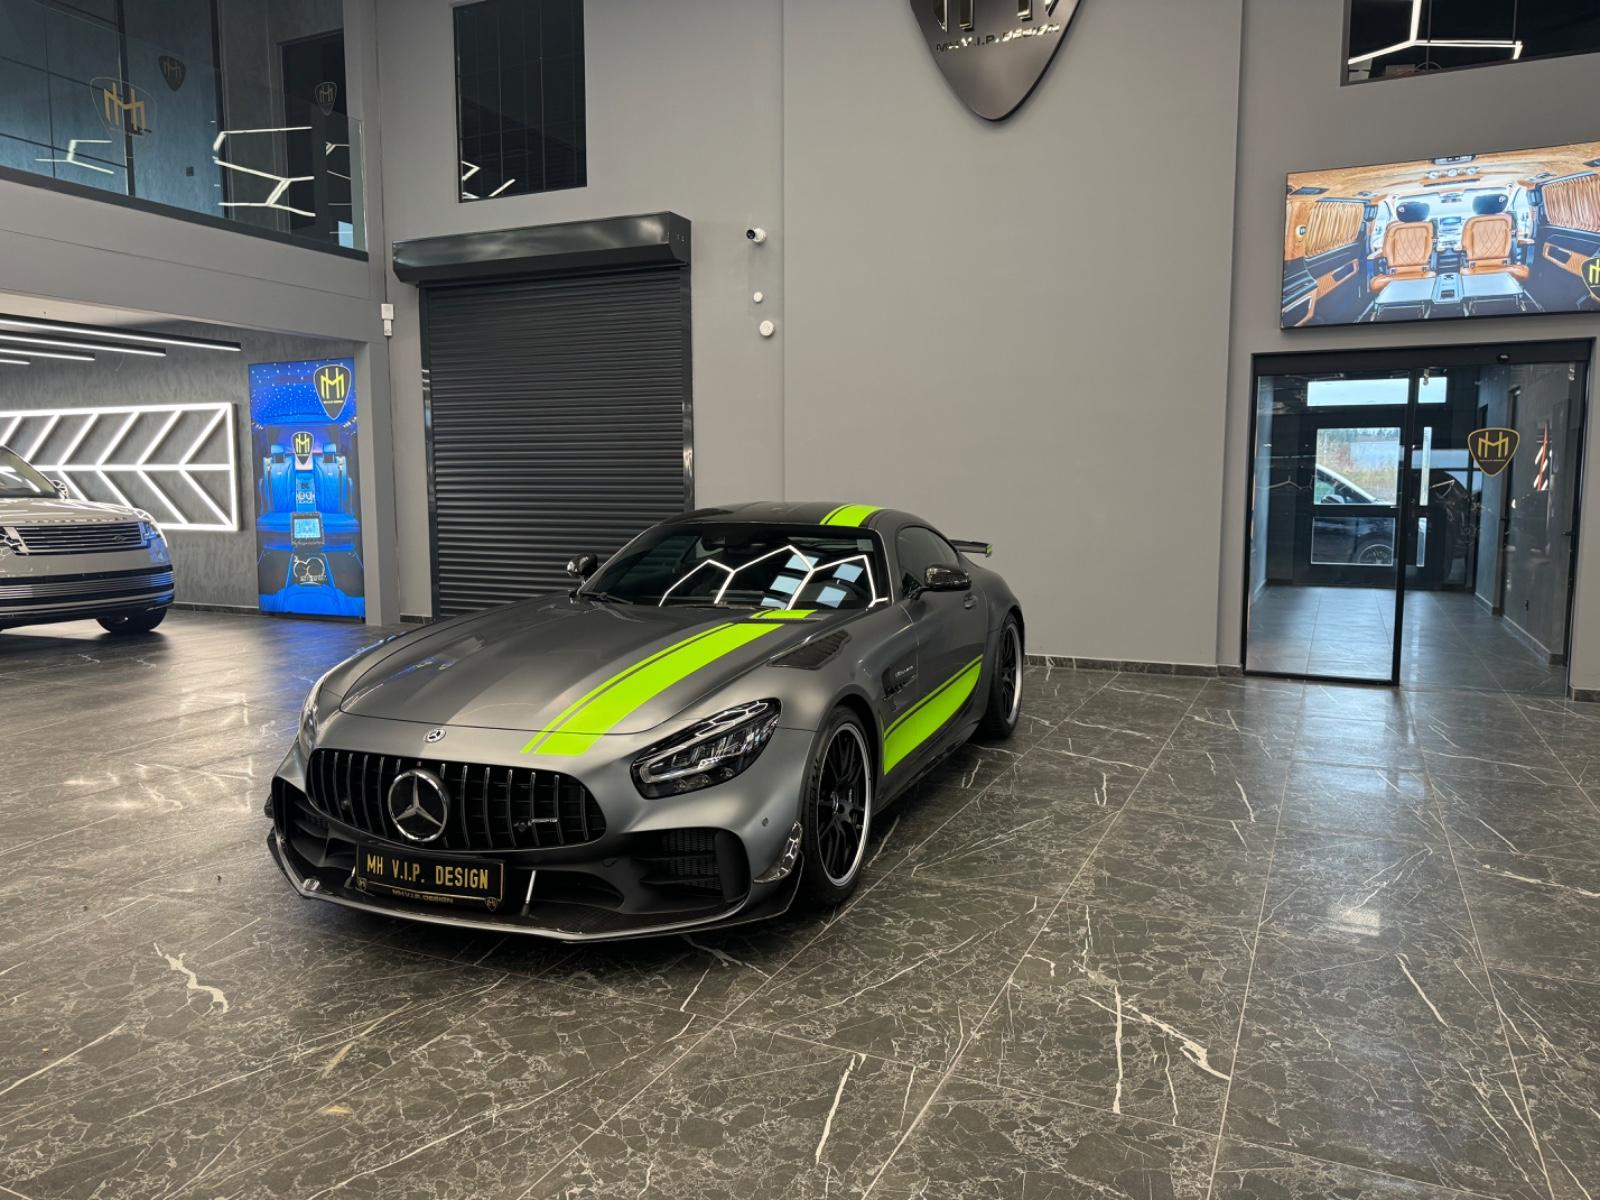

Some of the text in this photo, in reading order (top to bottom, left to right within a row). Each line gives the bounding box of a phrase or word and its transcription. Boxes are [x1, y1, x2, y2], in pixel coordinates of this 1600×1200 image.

[367, 854, 489, 890] MH V.I.P. DESIGN
